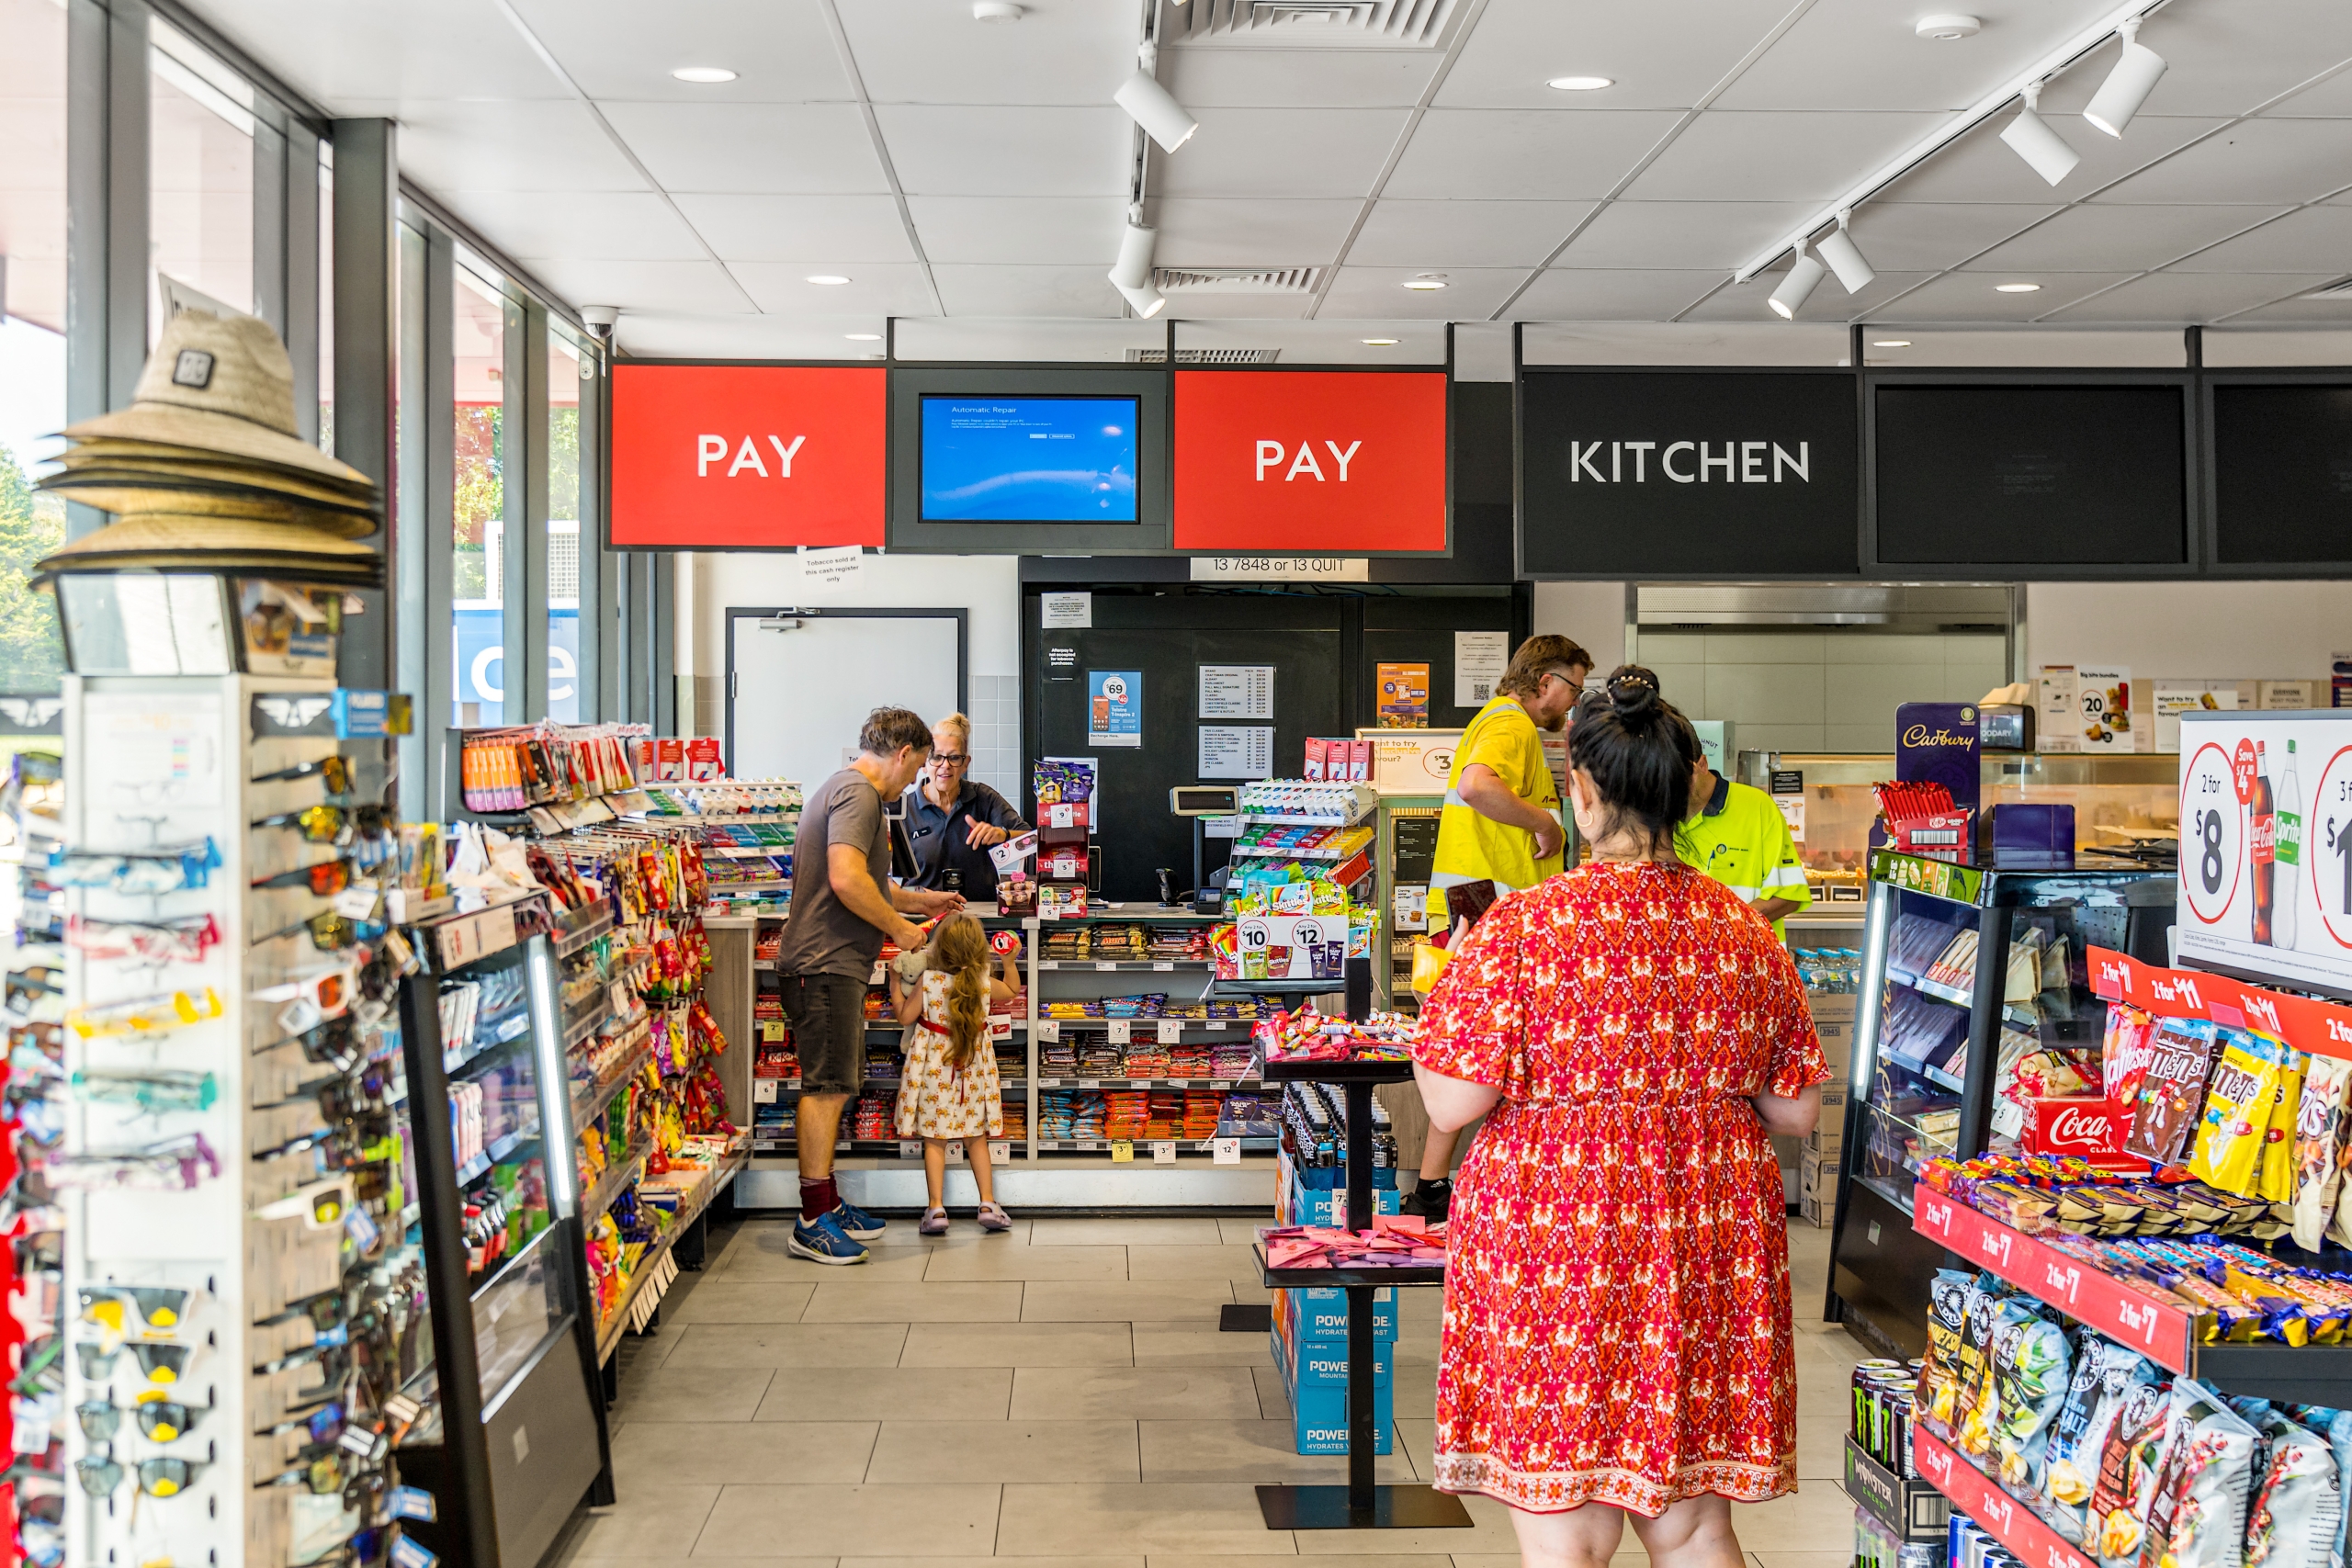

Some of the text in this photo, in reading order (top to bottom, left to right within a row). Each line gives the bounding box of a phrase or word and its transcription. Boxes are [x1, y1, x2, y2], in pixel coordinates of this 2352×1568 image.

[697, 435, 806, 477] PAY
[1255, 440, 1362, 482] PAY
[1570, 441, 1810, 483] KITCHEN
[1214, 558, 1346, 573] 13 7848 or 13 QUIT
[1903, 724, 1974, 752] Cadbury
[1435, 755, 1451, 770] $3
[2238, 748, 2253, 761] Save
[2202, 774, 2220, 793] 2 for
[2340, 781, 2345, 801] 3
[2275, 816, 2300, 845] Sprite
[2196, 807, 2222, 895] $8
[1272, 898, 1308, 911] Skittles
[1243, 931, 1265, 946] $10
[1297, 929, 1317, 944] $12
[2101, 960, 2132, 994] 2 for $11
[2151, 977, 2203, 1009] 2 for $11
[2240, 994, 2282, 1033] 2 for $11
[2326, 1018, 2352, 1043] 2 fo
[1927, 1202, 1952, 1237] 2 for $7
[1983, 1231, 2012, 1267] 2 for $7
[2047, 1263, 2080, 1304] 2 for $7
[2119, 1300, 2158, 1345] 2 for $7
[2061, 1409, 2088, 1437] SALT
[1927, 1446, 1953, 1486] 2 for $7
[1854, 1459, 1894, 1507] MONSTER
[1862, 1486, 1887, 1513] ENERGY
[1984, 1493, 2013, 1536] 2 for $7
